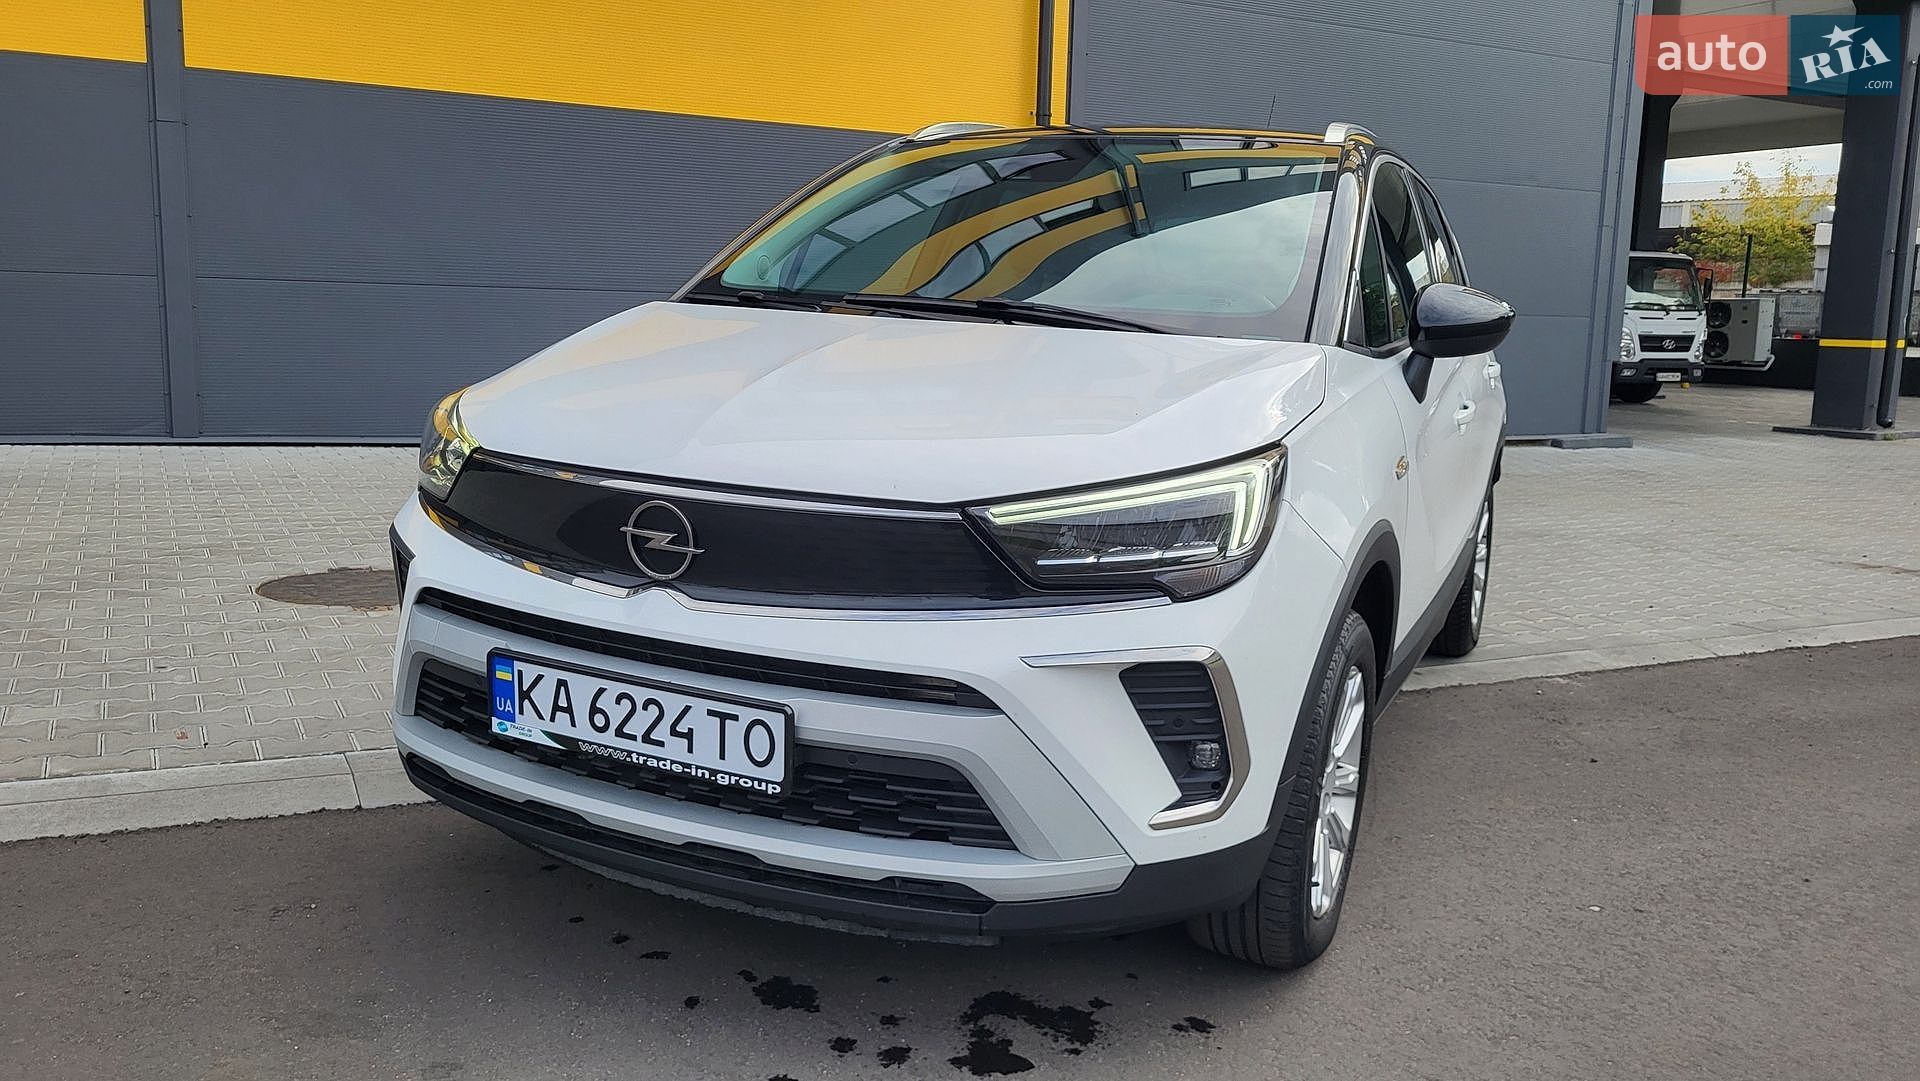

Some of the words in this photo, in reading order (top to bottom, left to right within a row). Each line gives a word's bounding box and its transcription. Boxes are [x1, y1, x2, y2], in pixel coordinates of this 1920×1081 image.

[496, 696, 513, 714] UA
[517, 669, 577, 728] KA
[588, 686, 694, 754] 6224
[706, 708, 776, 768] TO
[578, 740, 782, 795] www.trade-in.group
